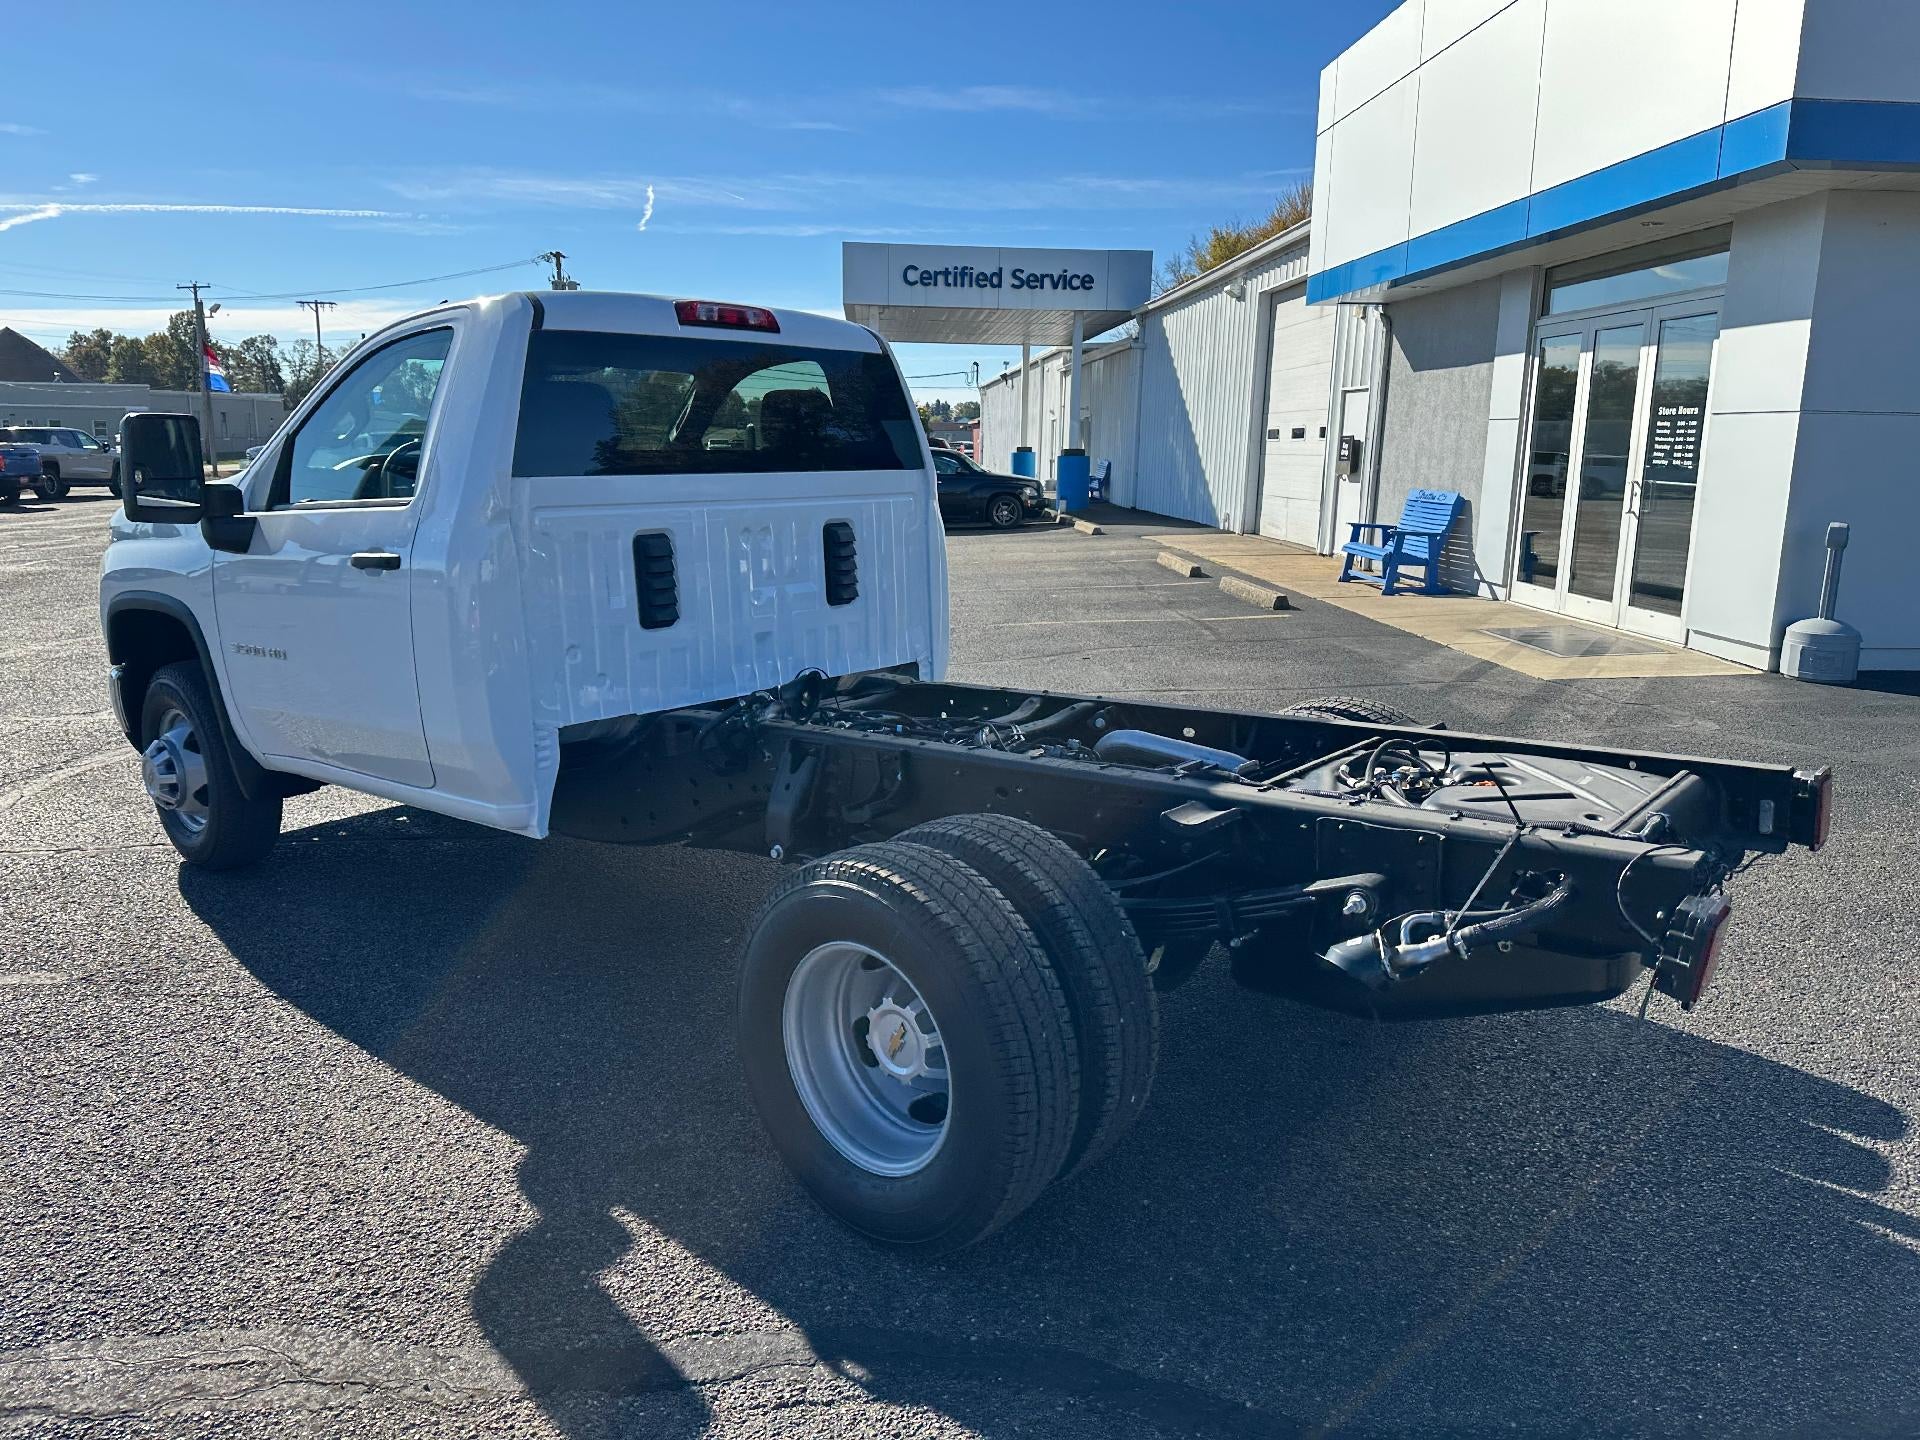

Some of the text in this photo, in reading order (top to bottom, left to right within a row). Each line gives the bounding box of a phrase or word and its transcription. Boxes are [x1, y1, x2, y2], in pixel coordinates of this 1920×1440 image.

[902, 264, 1095, 291] Certified Service
[1658, 405, 1699, 416] Store Hours
